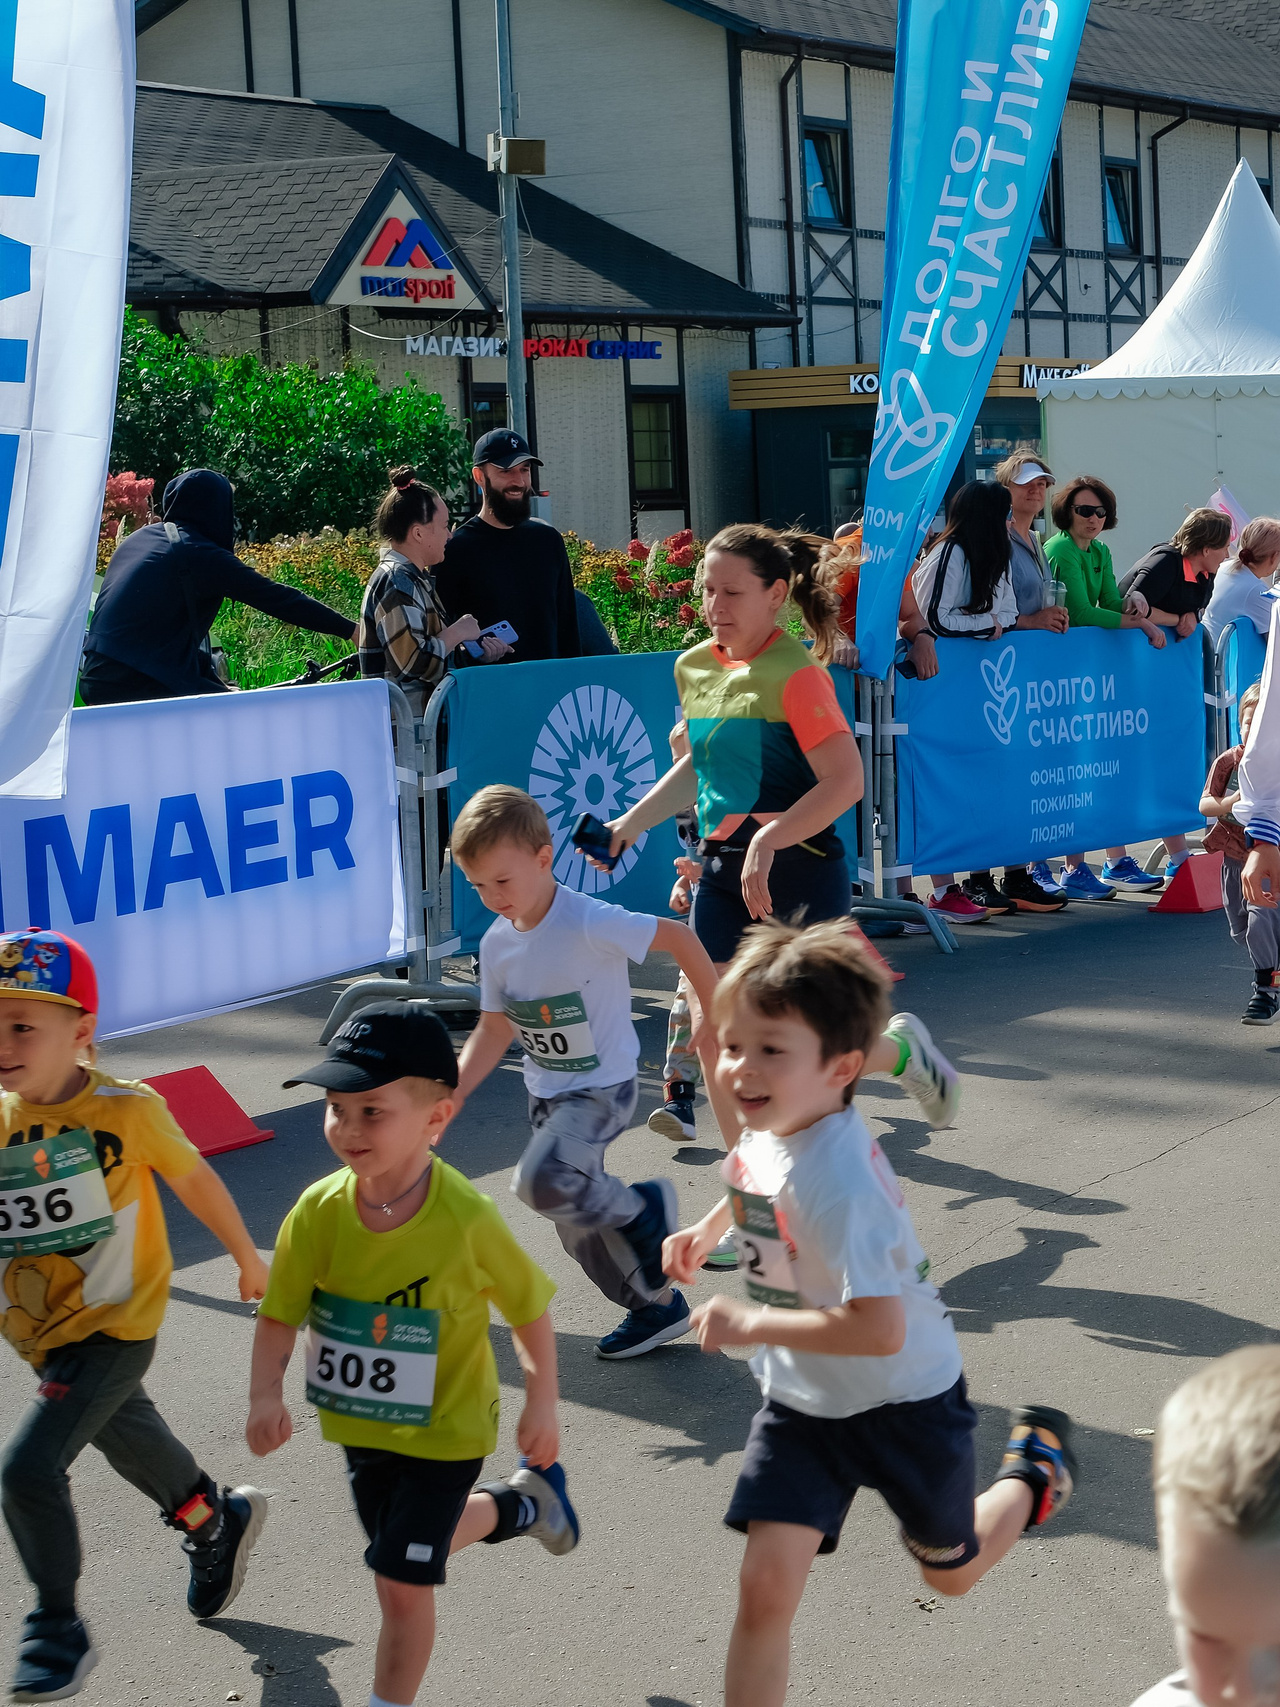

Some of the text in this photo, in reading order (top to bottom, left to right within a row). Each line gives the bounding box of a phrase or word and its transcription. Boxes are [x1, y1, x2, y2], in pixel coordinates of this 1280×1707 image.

[898, 60, 1000, 355] ДОЛГО И
[590, 340, 662, 360] СЕРВИС
[850, 374, 880, 394] КО
[1025, 674, 1115, 714] ДОЛГО И
[1028, 707, 1149, 748] СЧАСТЛИВО
[1030, 759, 1120, 787] ФОНД ПОМОЩИ
[1031, 791, 1093, 816] ПОЖИЛЫМ
[1029, 822, 1075, 844] ЛЮДЯМ
[23, 769, 357, 931] MAER
[520, 1028, 569, 1055] 550
[53, 1146, 88, 1162] ОГОНЬ
[55, 1153, 93, 1171] ЖИЗНИ
[317, 1344, 396, 1393] 508
